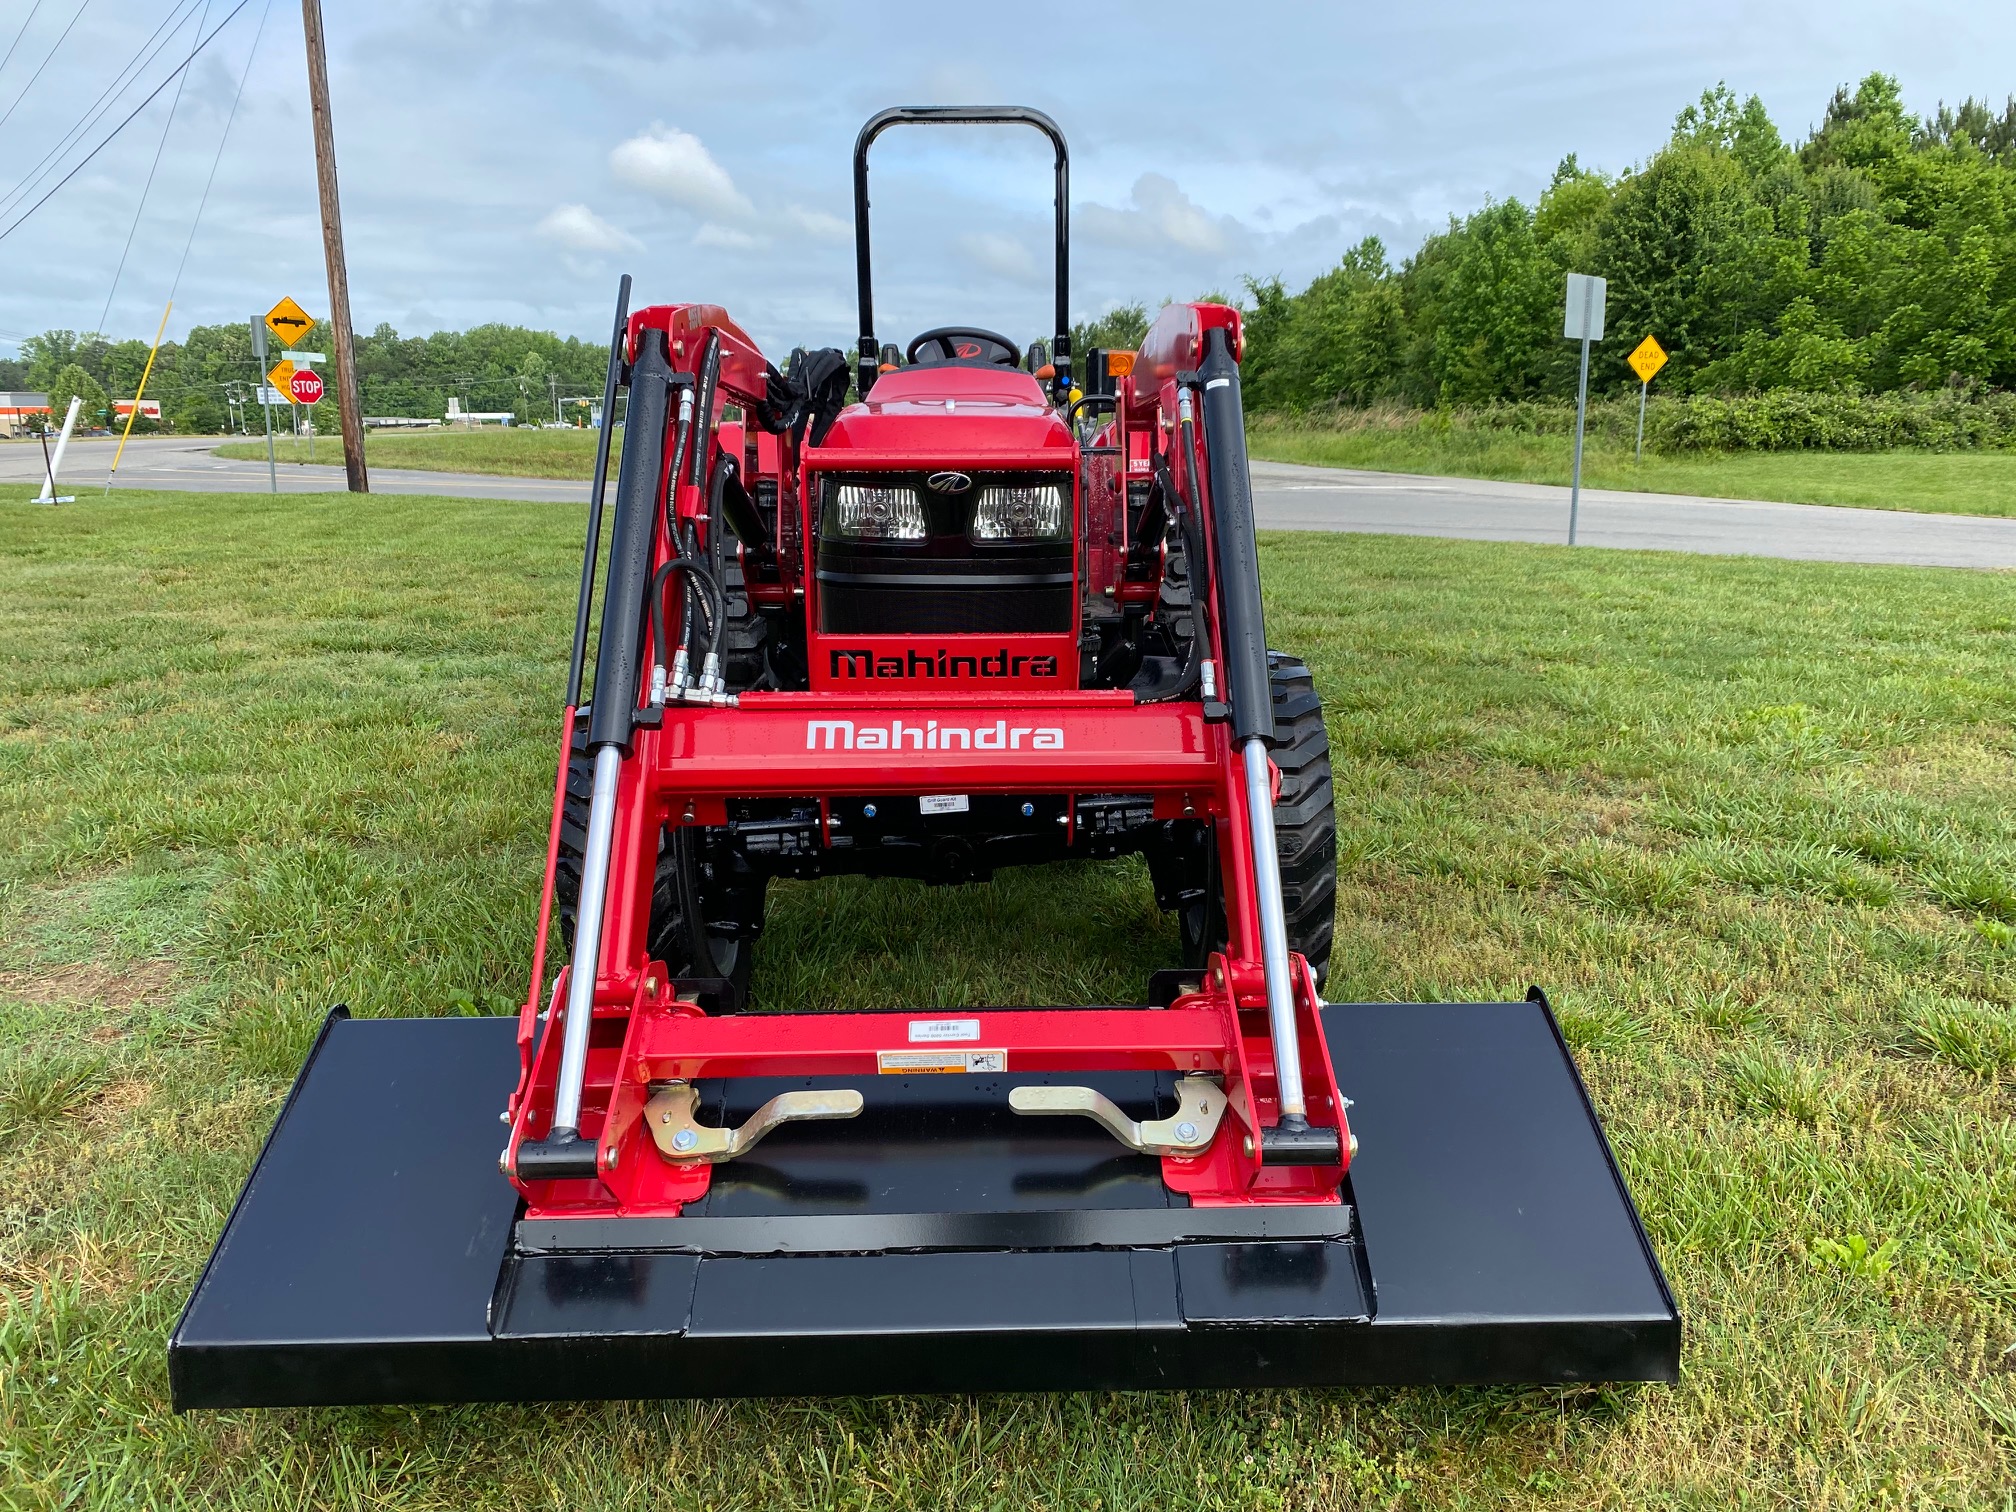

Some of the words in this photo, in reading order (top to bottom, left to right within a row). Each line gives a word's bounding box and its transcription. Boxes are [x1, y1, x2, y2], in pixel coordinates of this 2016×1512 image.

[1640, 362, 1656, 370] END
[292, 380, 320, 394] STOP
[830, 649, 1058, 679] Mahindra
[806, 720, 1064, 749] Mahindra
